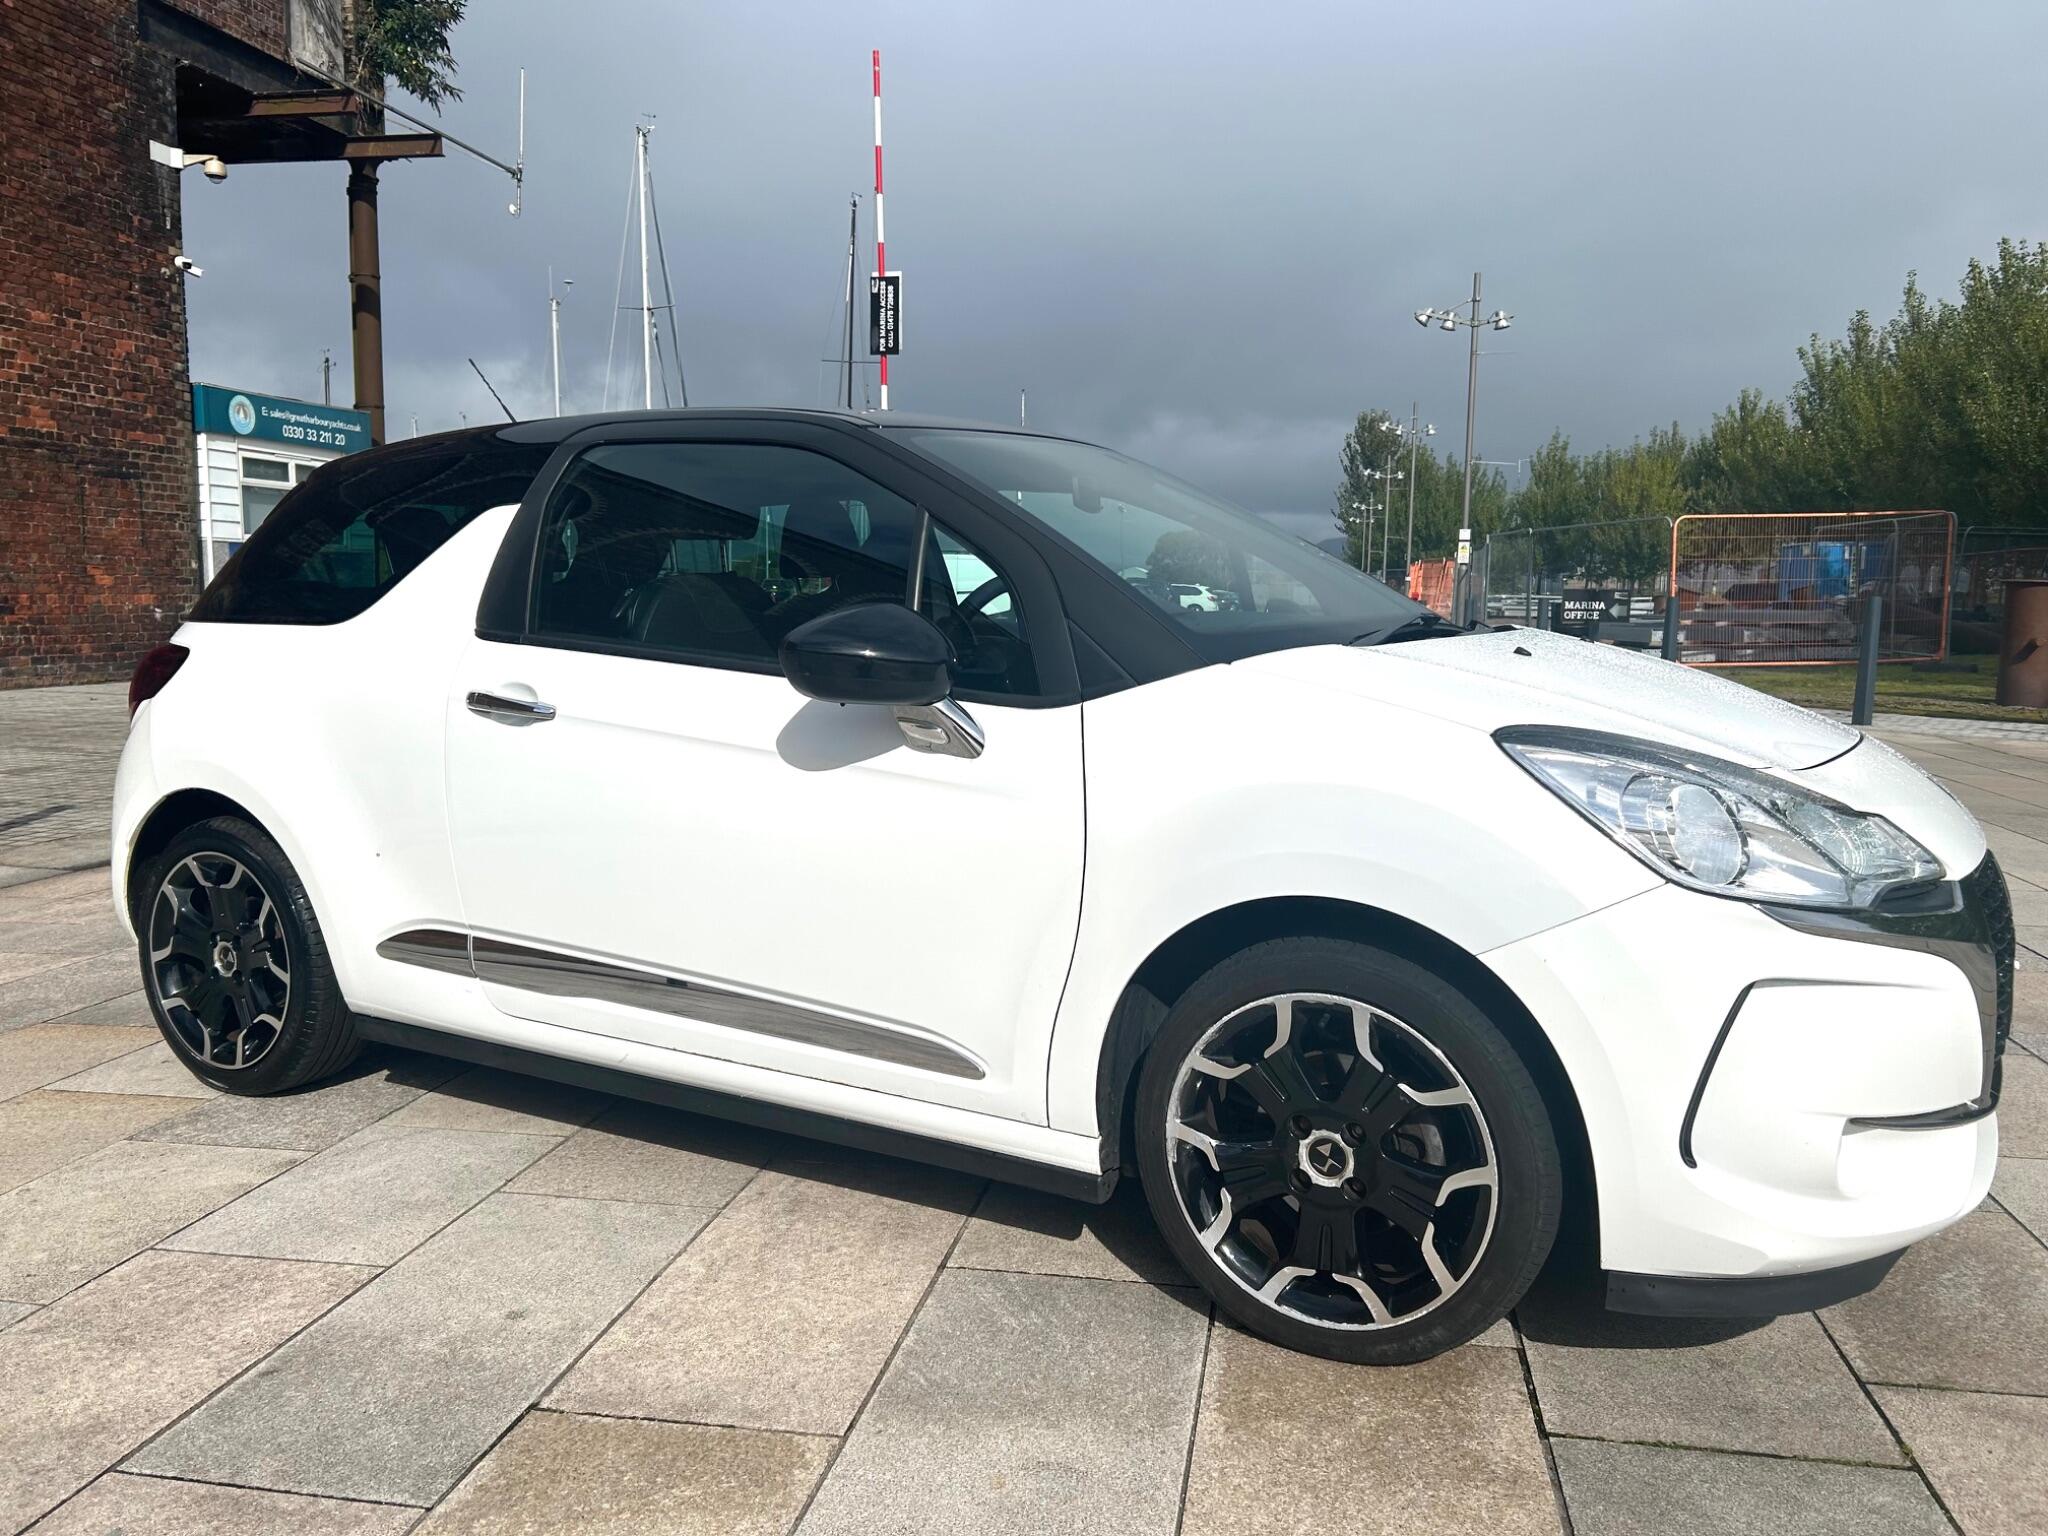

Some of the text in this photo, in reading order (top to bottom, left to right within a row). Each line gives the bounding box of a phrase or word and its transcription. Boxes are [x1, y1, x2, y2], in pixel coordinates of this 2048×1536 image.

[282, 425, 346, 446] 0330 33 211 20
[1564, 601, 1606, 610] MARINA
[1563, 610, 1600, 620] OFFICE
